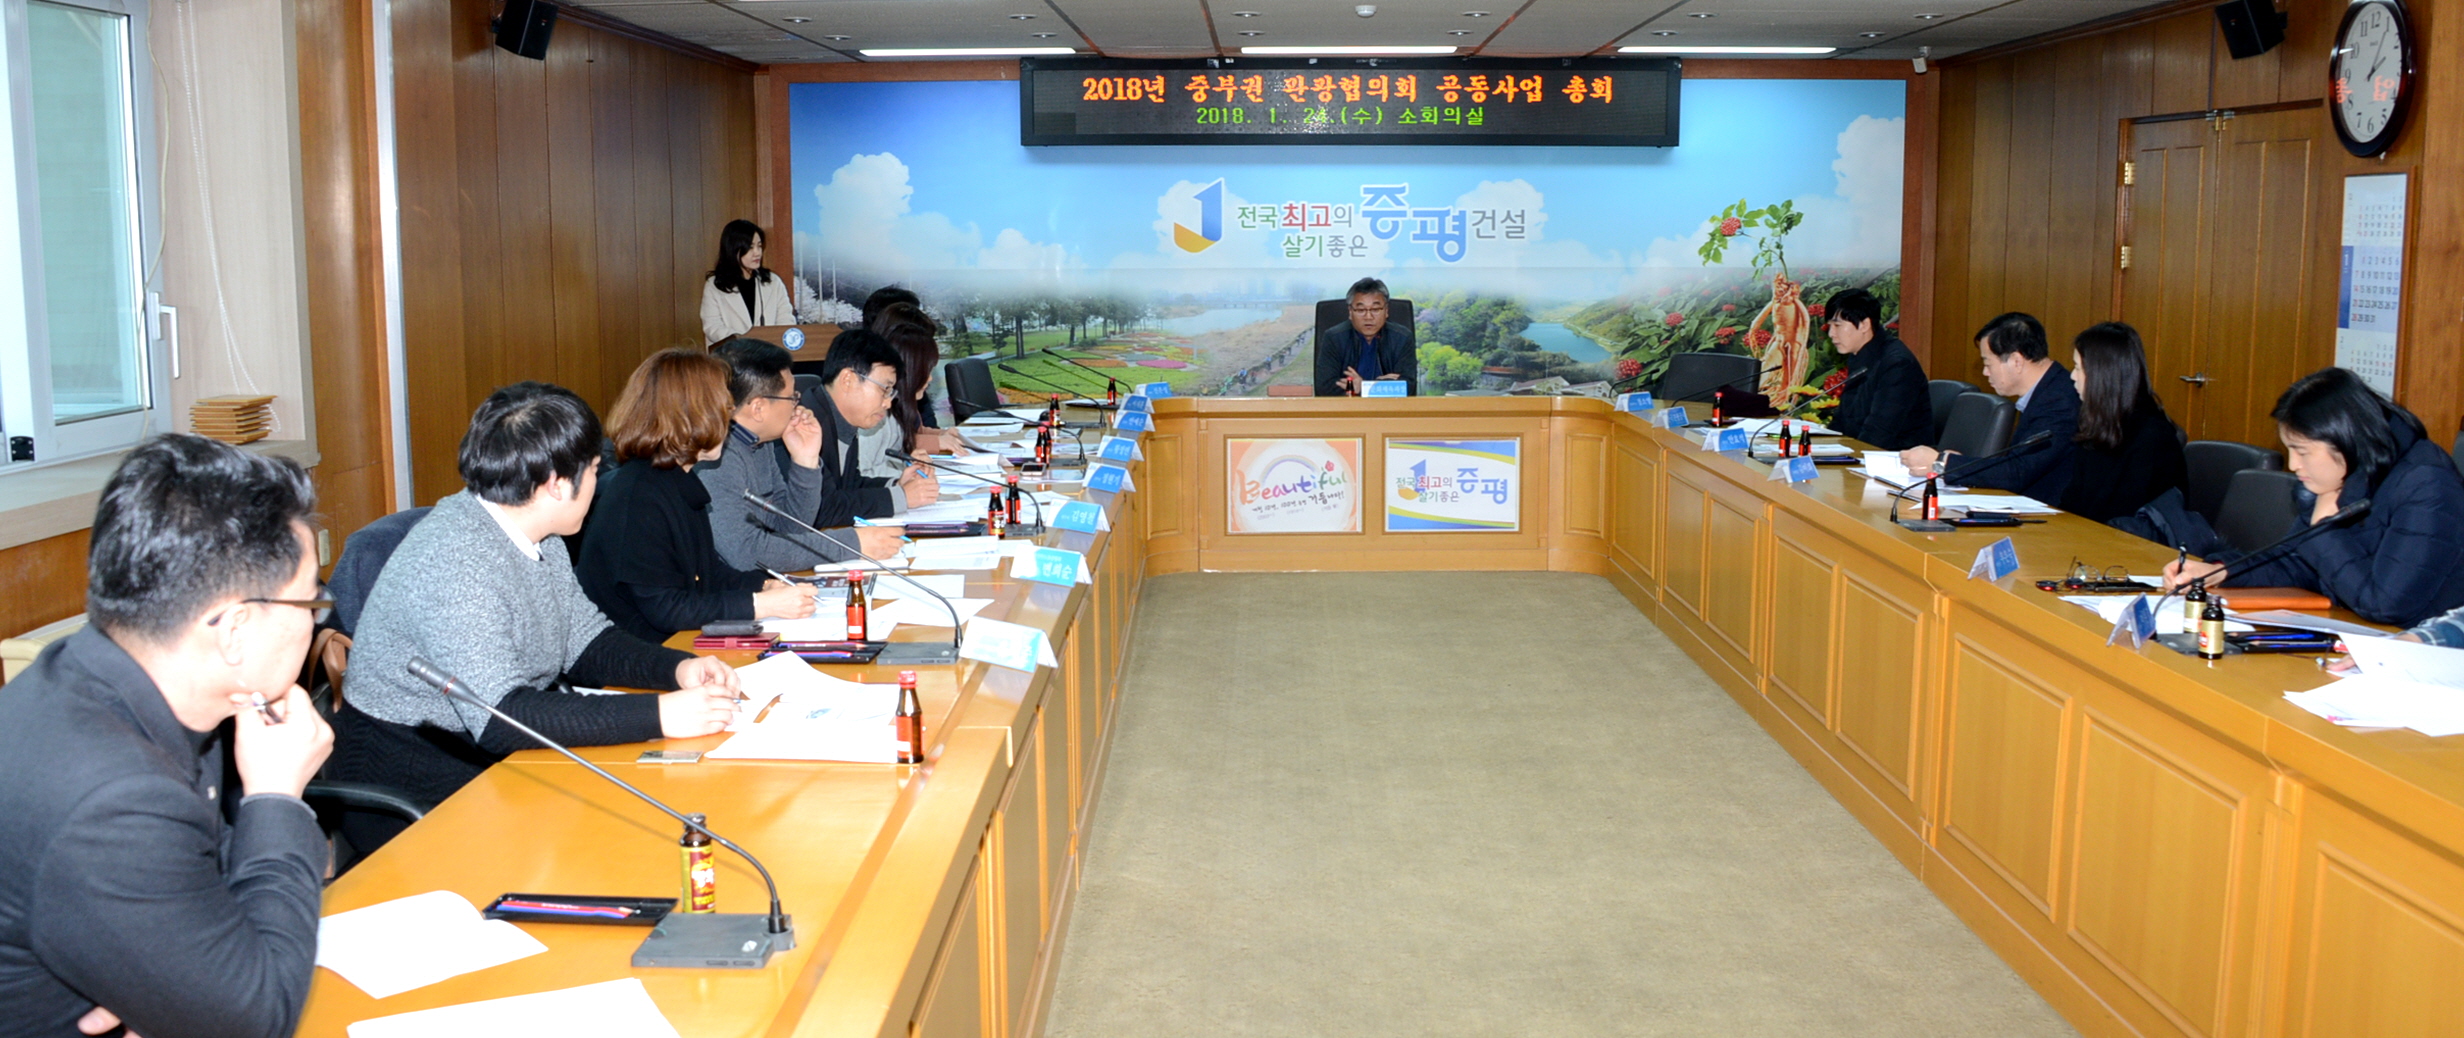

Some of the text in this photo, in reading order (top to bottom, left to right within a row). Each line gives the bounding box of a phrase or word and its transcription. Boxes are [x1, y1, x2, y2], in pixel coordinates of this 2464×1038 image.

[2360, 21, 2369, 37] 11
[2371, 11, 2380, 29] 12
[1082, 75, 1613, 103] 2018년 중부권 관광협의회 공동사업 총회
[1196, 107, 1252, 124] 2018.
[1269, 107, 1288, 124] 1.
[1398, 106, 1484, 126] 소회의실
[2367, 117, 2374, 133] 6
[1361, 184, 1467, 262] 증평
[1471, 208, 1527, 239] 건설
[1236, 463, 1347, 505] Beautiful
[1457, 467, 1507, 504] 증평
